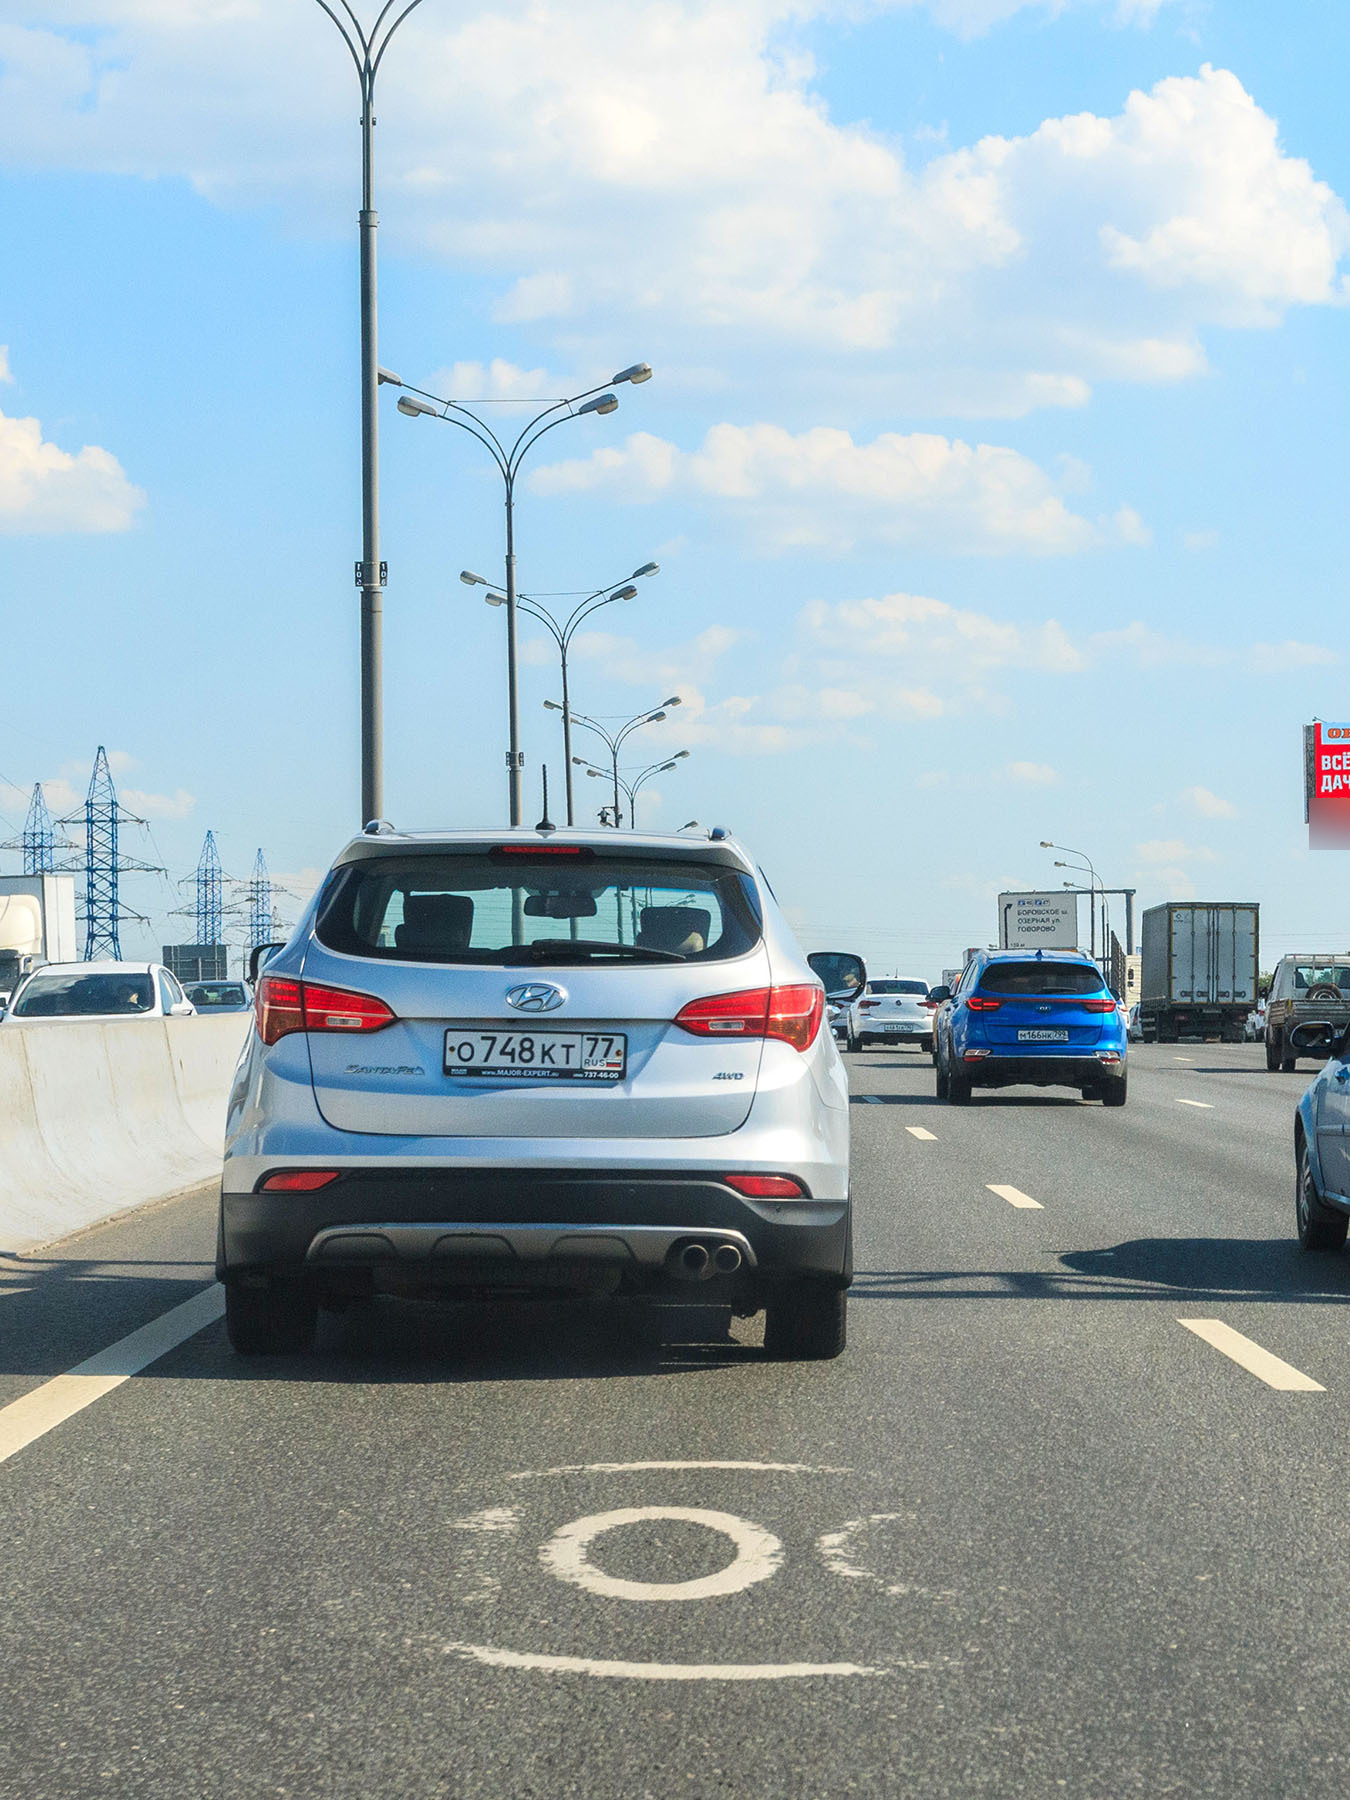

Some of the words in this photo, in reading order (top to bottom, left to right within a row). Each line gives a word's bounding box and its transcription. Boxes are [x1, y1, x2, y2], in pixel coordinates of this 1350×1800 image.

[1321, 752, 1350, 770] ВСЁ
[457, 1036, 576, 1064] О748КТ
[585, 1037, 615, 1059] 77
[584, 1059, 606, 1067] RUS
